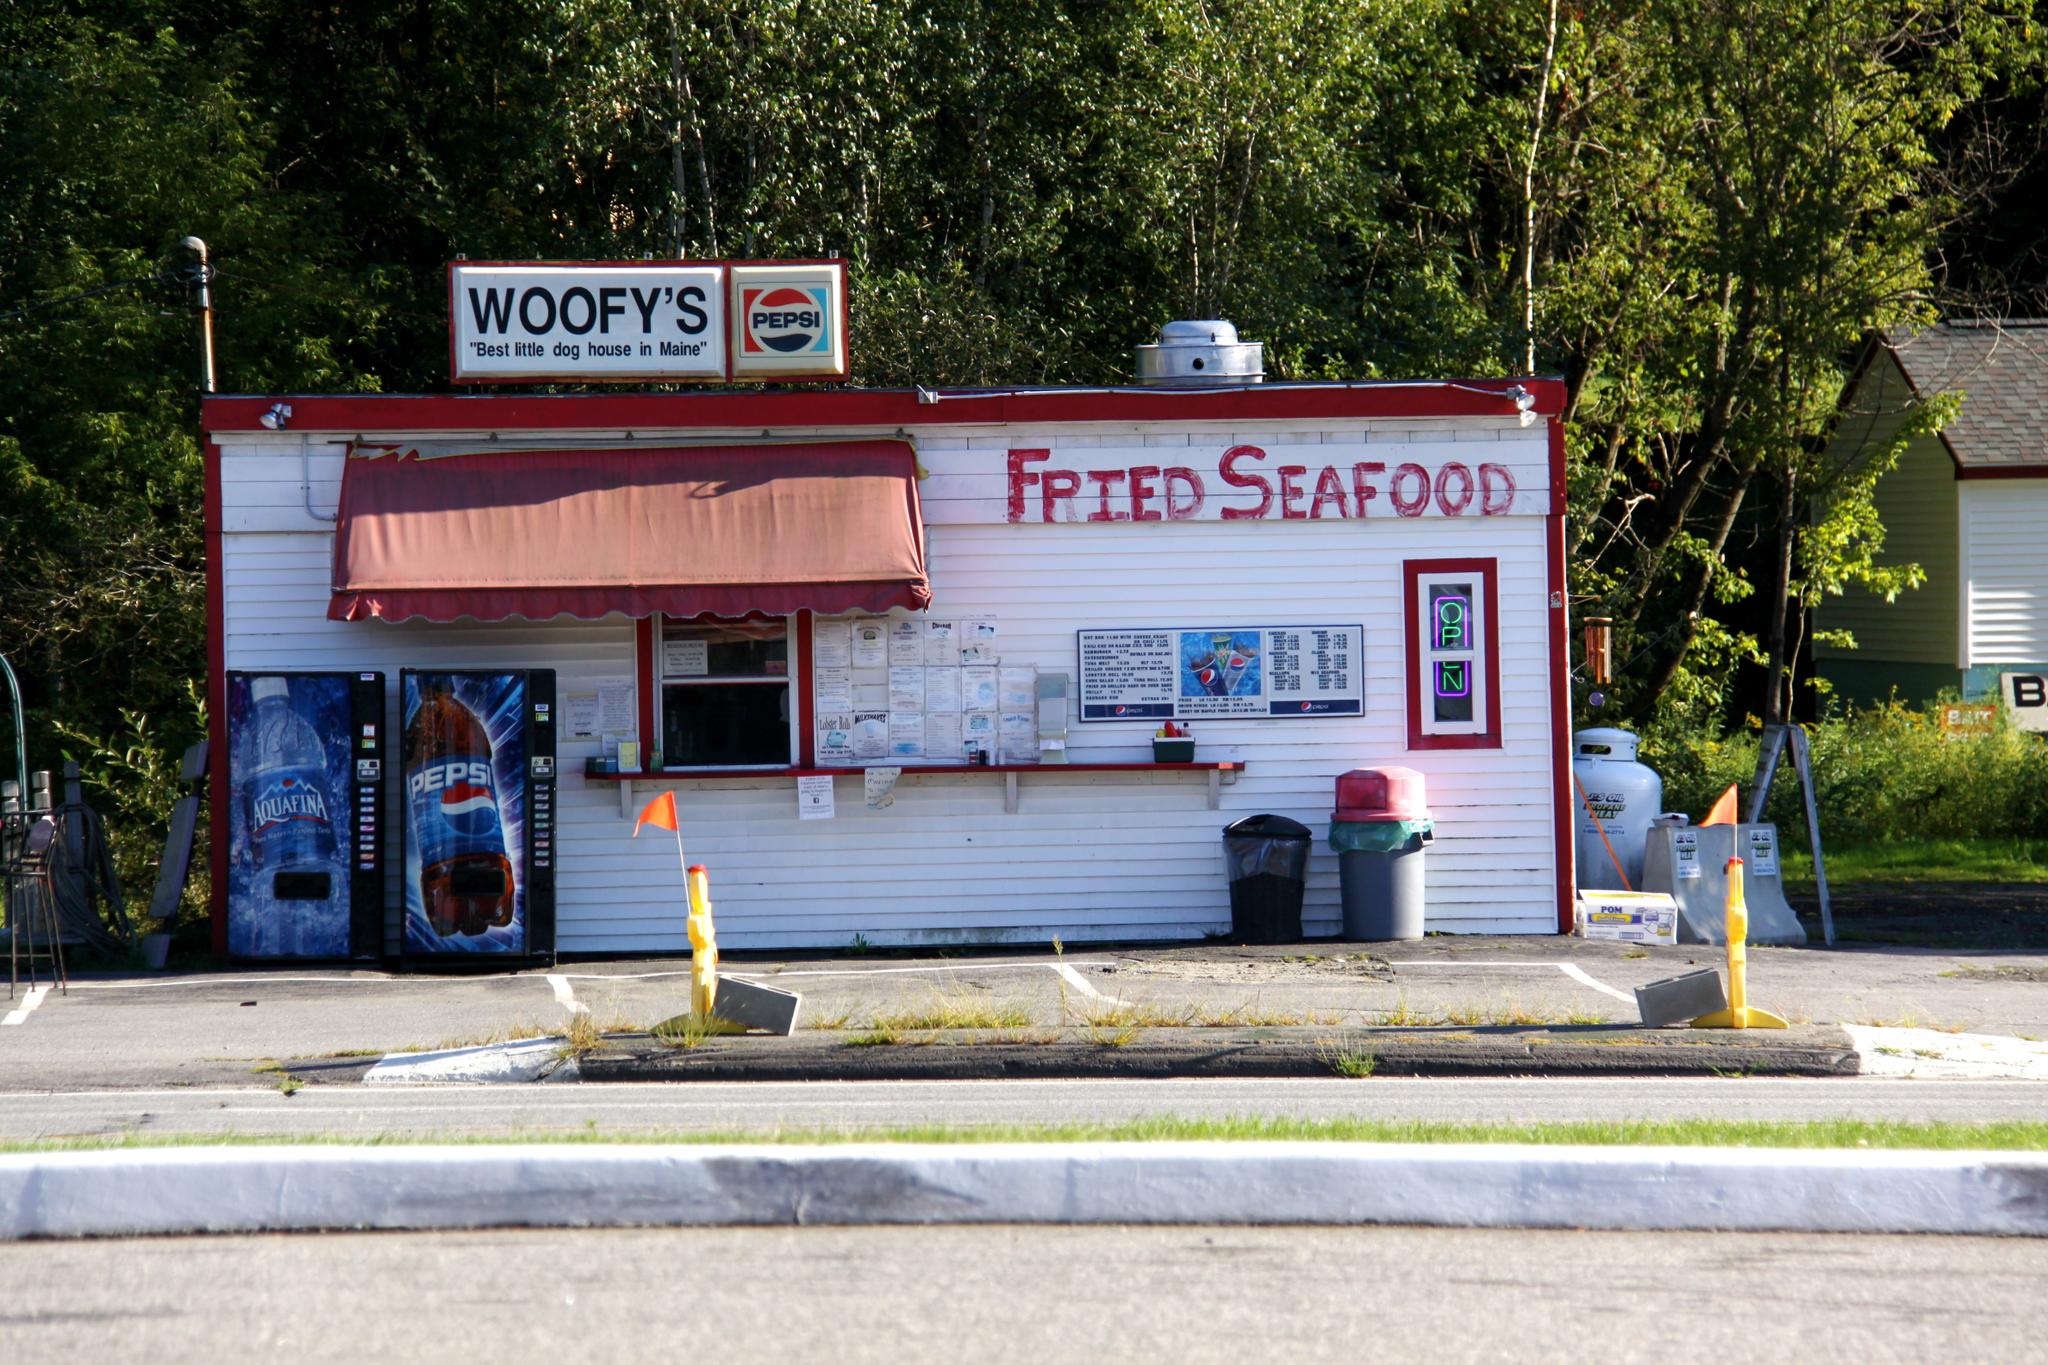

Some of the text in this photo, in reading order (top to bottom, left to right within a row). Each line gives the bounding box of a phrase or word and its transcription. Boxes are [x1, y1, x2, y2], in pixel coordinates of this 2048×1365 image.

[468, 286, 708, 335] WOOFY'S
[752, 310, 820, 329] PEPSI
[470, 341, 707, 360] "Best little dog house in Maine"
[1007, 444, 1516, 523] FRIED SEAFOOD
[411, 762, 492, 800] PEPSI
[254, 790, 328, 832] AQUAFINA
